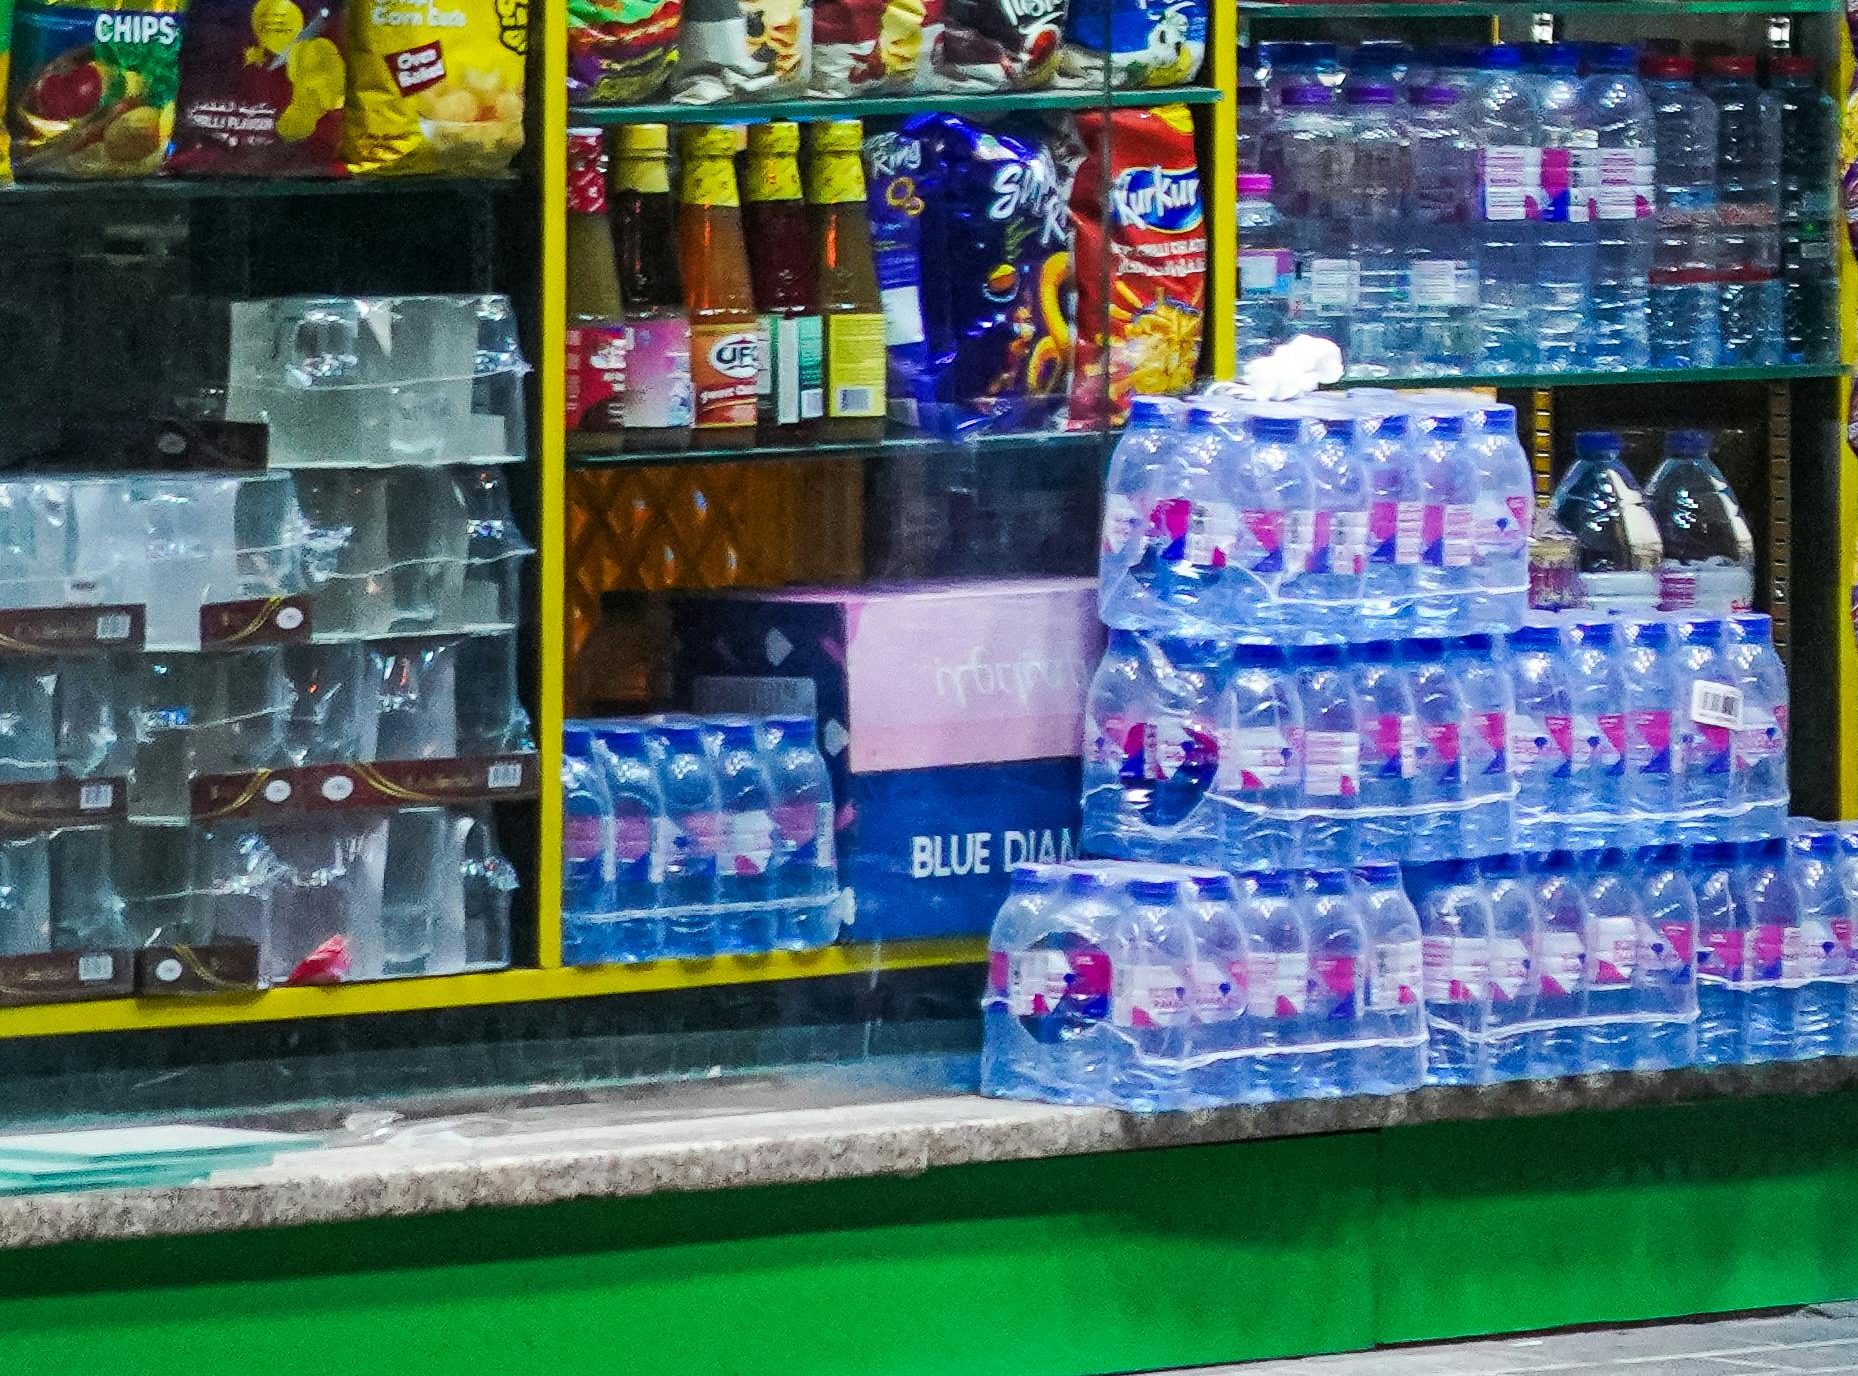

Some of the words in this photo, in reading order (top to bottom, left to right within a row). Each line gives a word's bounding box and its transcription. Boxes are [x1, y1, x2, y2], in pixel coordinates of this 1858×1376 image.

[94, 13, 178, 46] CHIPS
[1110, 165, 1200, 231] Kurkur
[910, 828, 992, 879] BLUE
